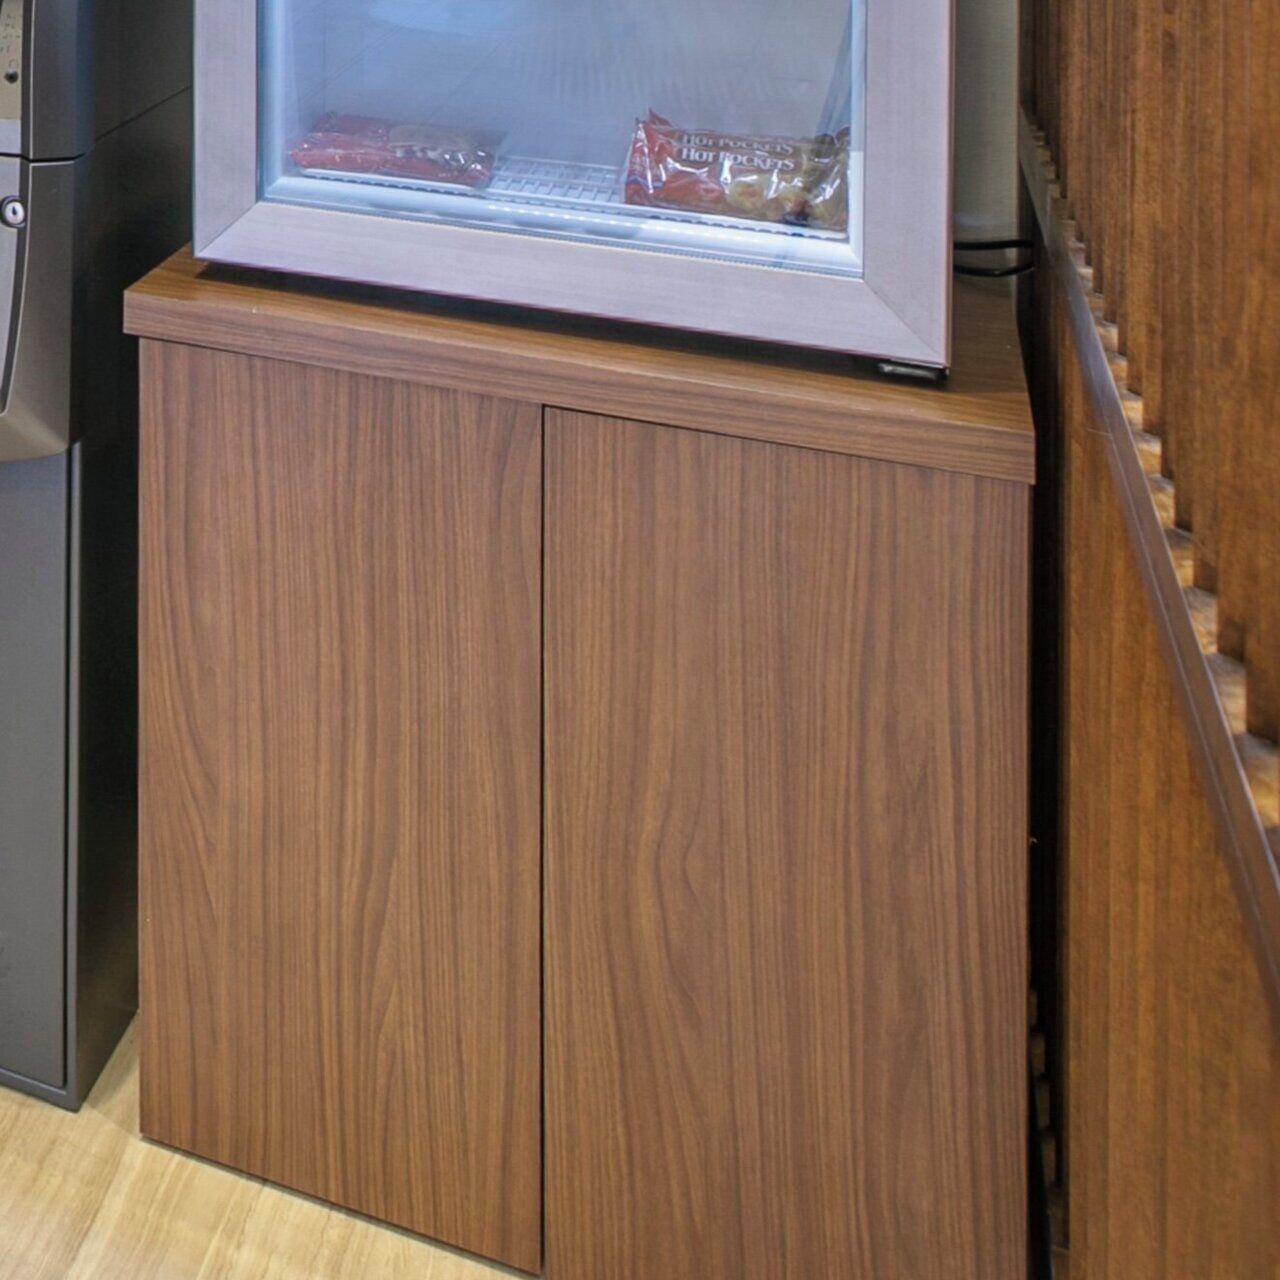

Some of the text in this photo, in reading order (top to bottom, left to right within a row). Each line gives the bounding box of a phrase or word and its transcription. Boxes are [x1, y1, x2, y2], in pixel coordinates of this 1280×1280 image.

[682, 133, 793, 155] HOT POCKETS
[681, 148, 795, 171] HOT POCKETS
